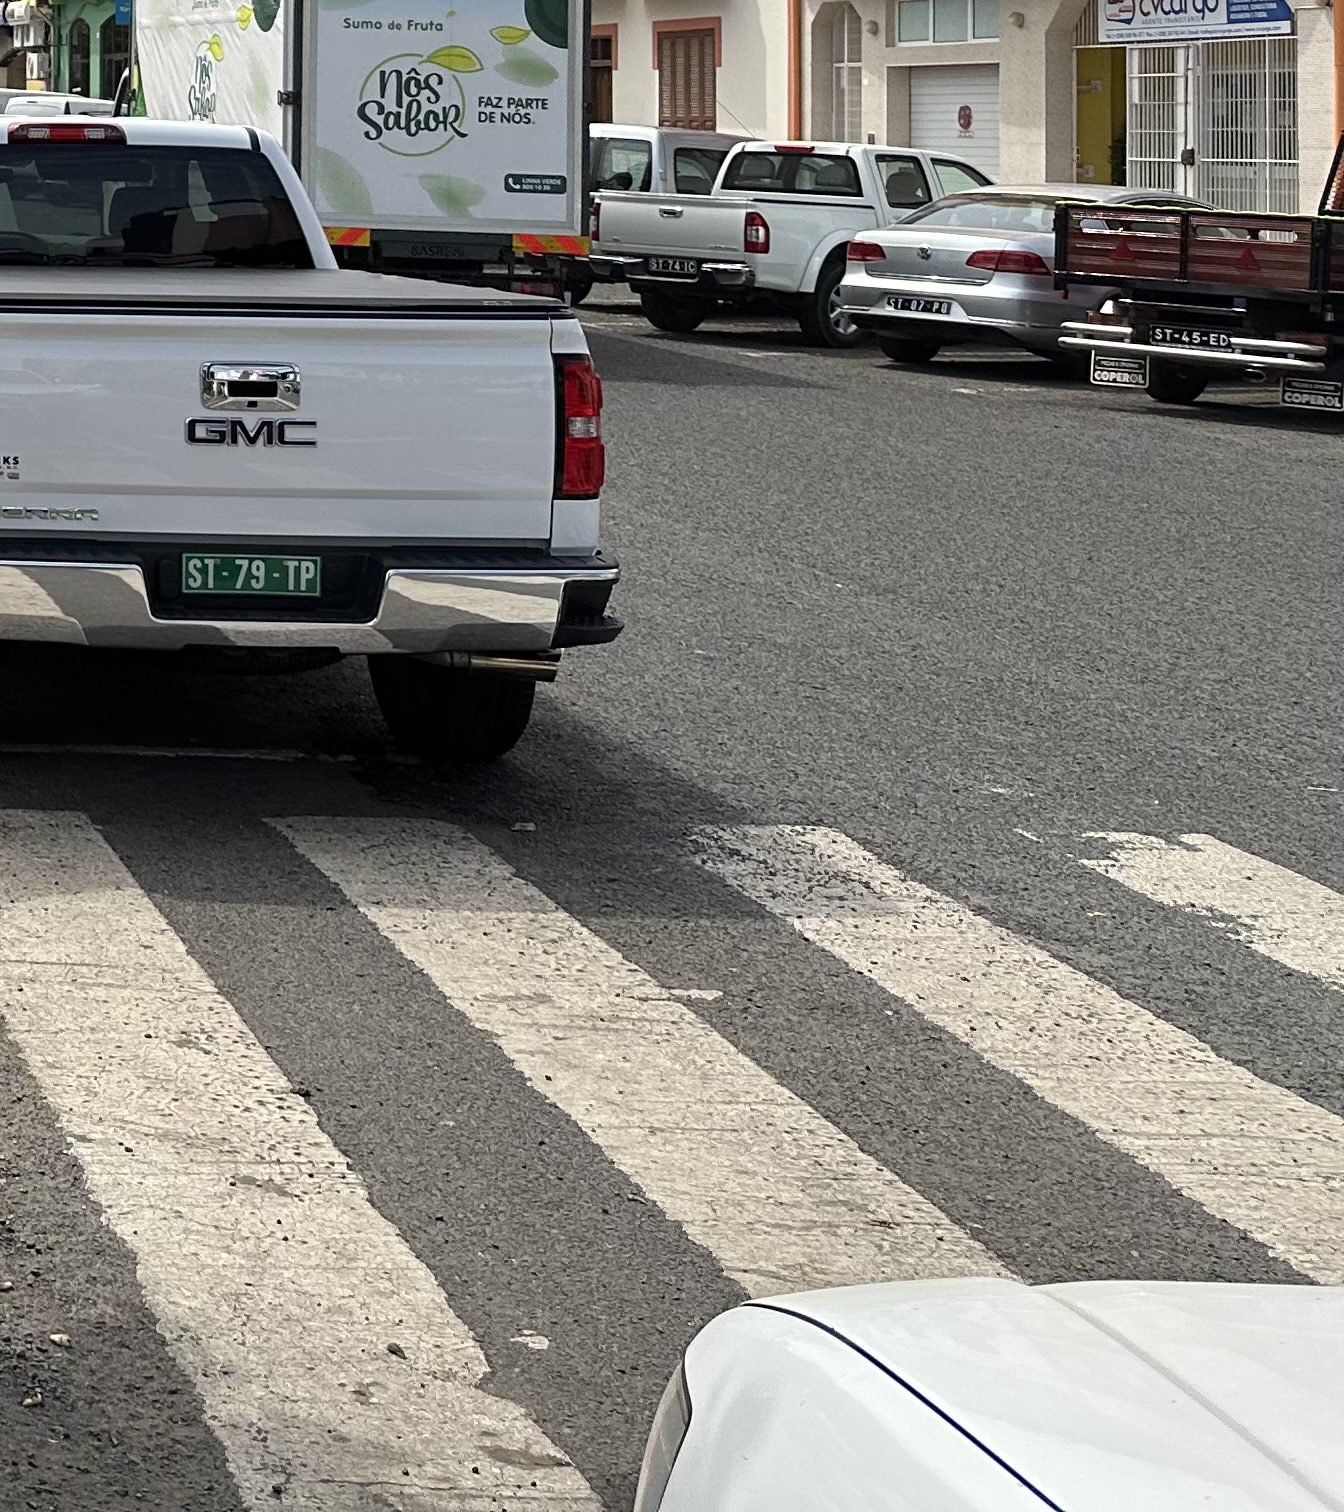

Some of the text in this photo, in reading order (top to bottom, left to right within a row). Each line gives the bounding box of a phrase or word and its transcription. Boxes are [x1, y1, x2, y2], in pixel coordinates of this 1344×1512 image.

[343, 17, 444, 32] Sumo de Fruta
[478, 96, 549, 111] FAZ PARTE
[478, 111, 497, 124] DE
[1153, 327, 1229, 347] ST-45-ED
[1094, 370, 1145, 384] COPEROL
[1283, 390, 1342, 409] COPEROL
[185, 416, 318, 448] GMC
[187, 558, 316, 592] ST-79-TP
